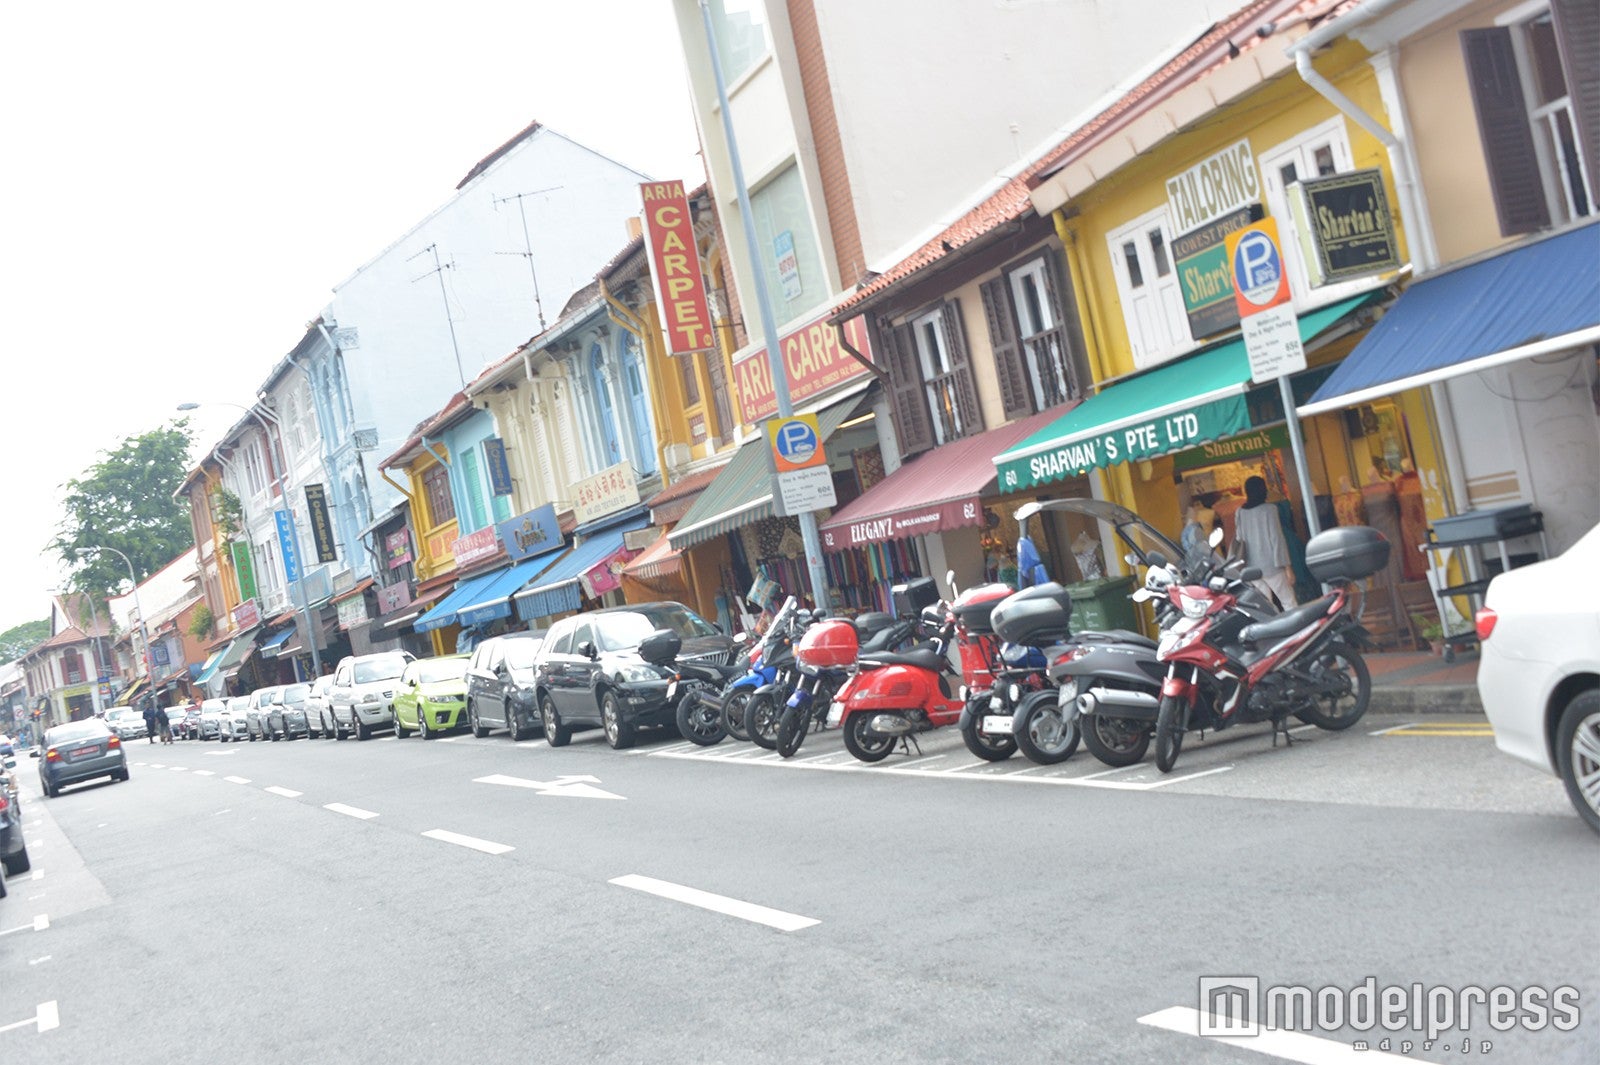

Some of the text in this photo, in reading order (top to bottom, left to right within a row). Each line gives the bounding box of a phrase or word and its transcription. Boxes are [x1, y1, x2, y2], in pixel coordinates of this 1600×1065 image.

[643, 183, 684, 202] ARIA
[1167, 142, 1258, 230] TAILORING
[1174, 214, 1247, 257] LOWEST PRICE
[1318, 196, 1383, 239] Sharvan's
[654, 206, 704, 350] CARPET
[1184, 260, 1235, 304] Sharv
[741, 354, 775, 404] ARI
[746, 404, 758, 420] 64
[1029, 412, 1200, 481] SHARVAN'S PTE LTD
[1203, 431, 1273, 460] Sharvan's
[1004, 468, 1018, 488] 60
[962, 502, 978, 520] 62
[824, 532, 836, 547] 62
